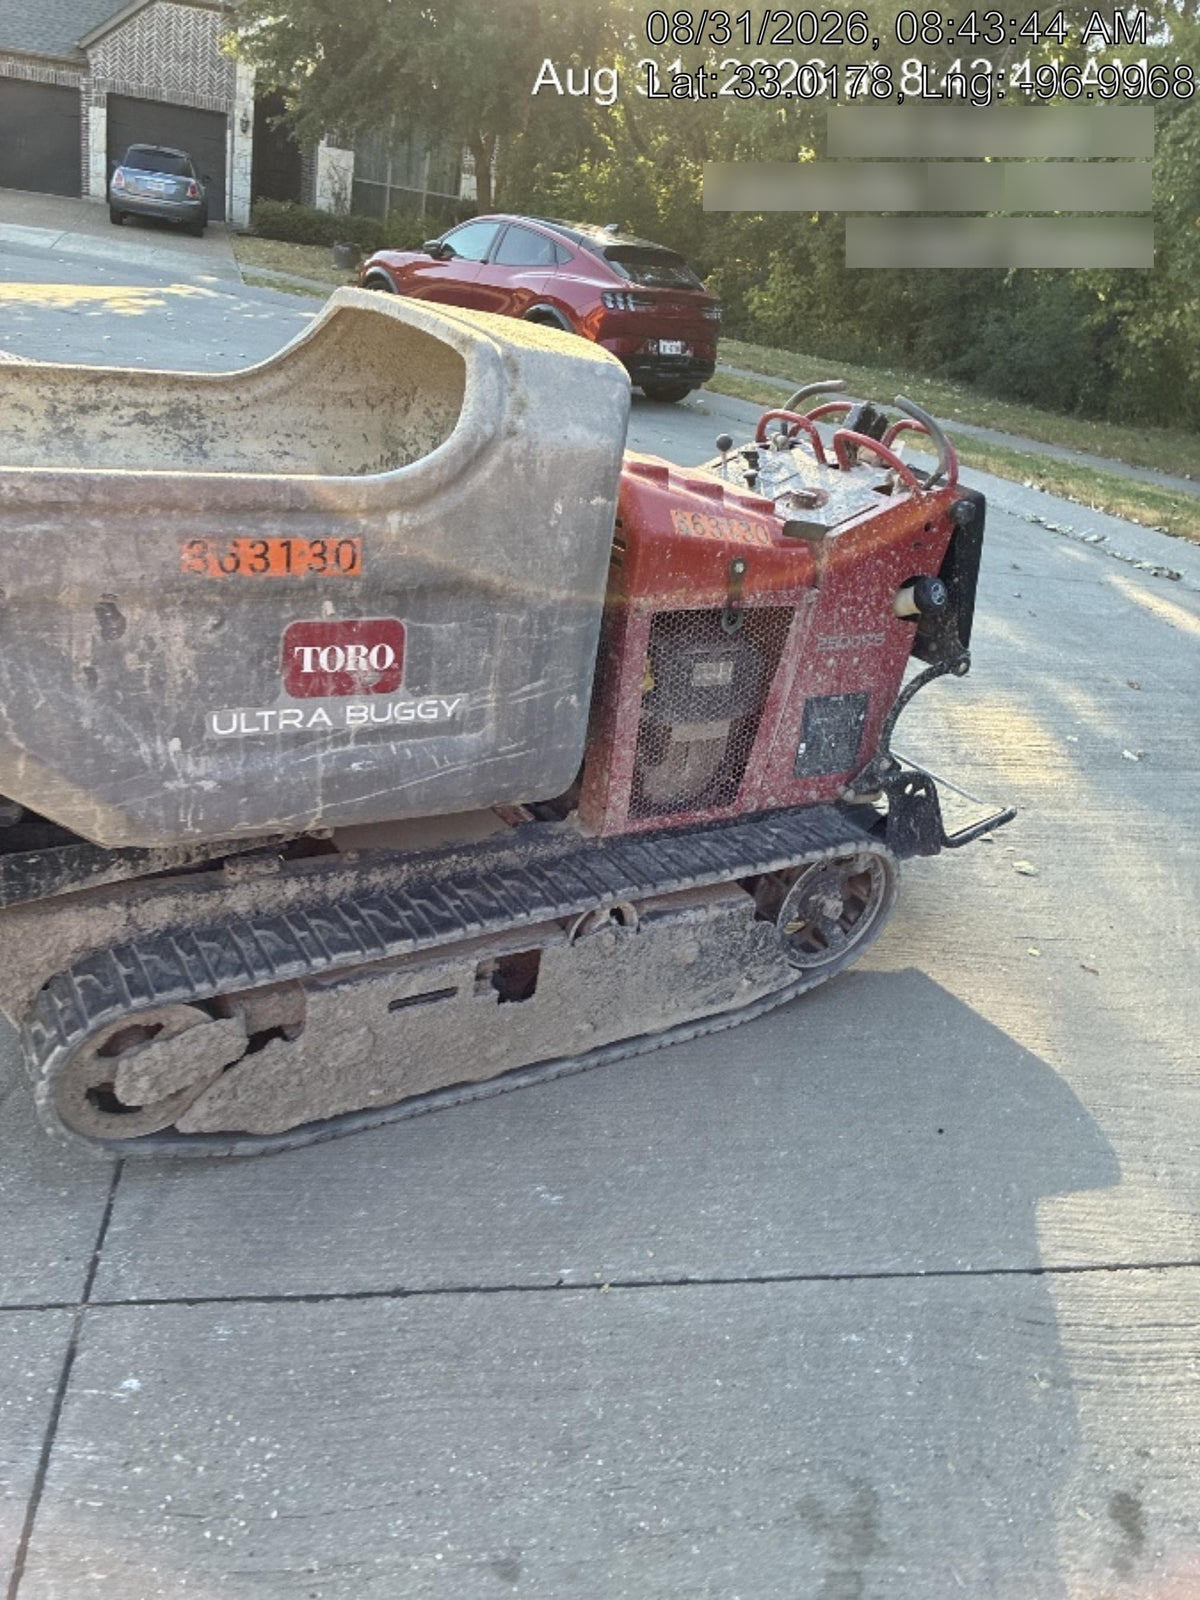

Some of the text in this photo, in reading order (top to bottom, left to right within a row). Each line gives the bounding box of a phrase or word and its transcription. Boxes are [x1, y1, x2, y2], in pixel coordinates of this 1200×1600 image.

[294, 643, 395, 673] TORO
[212, 698, 457, 735] ULTRA BUGGY
